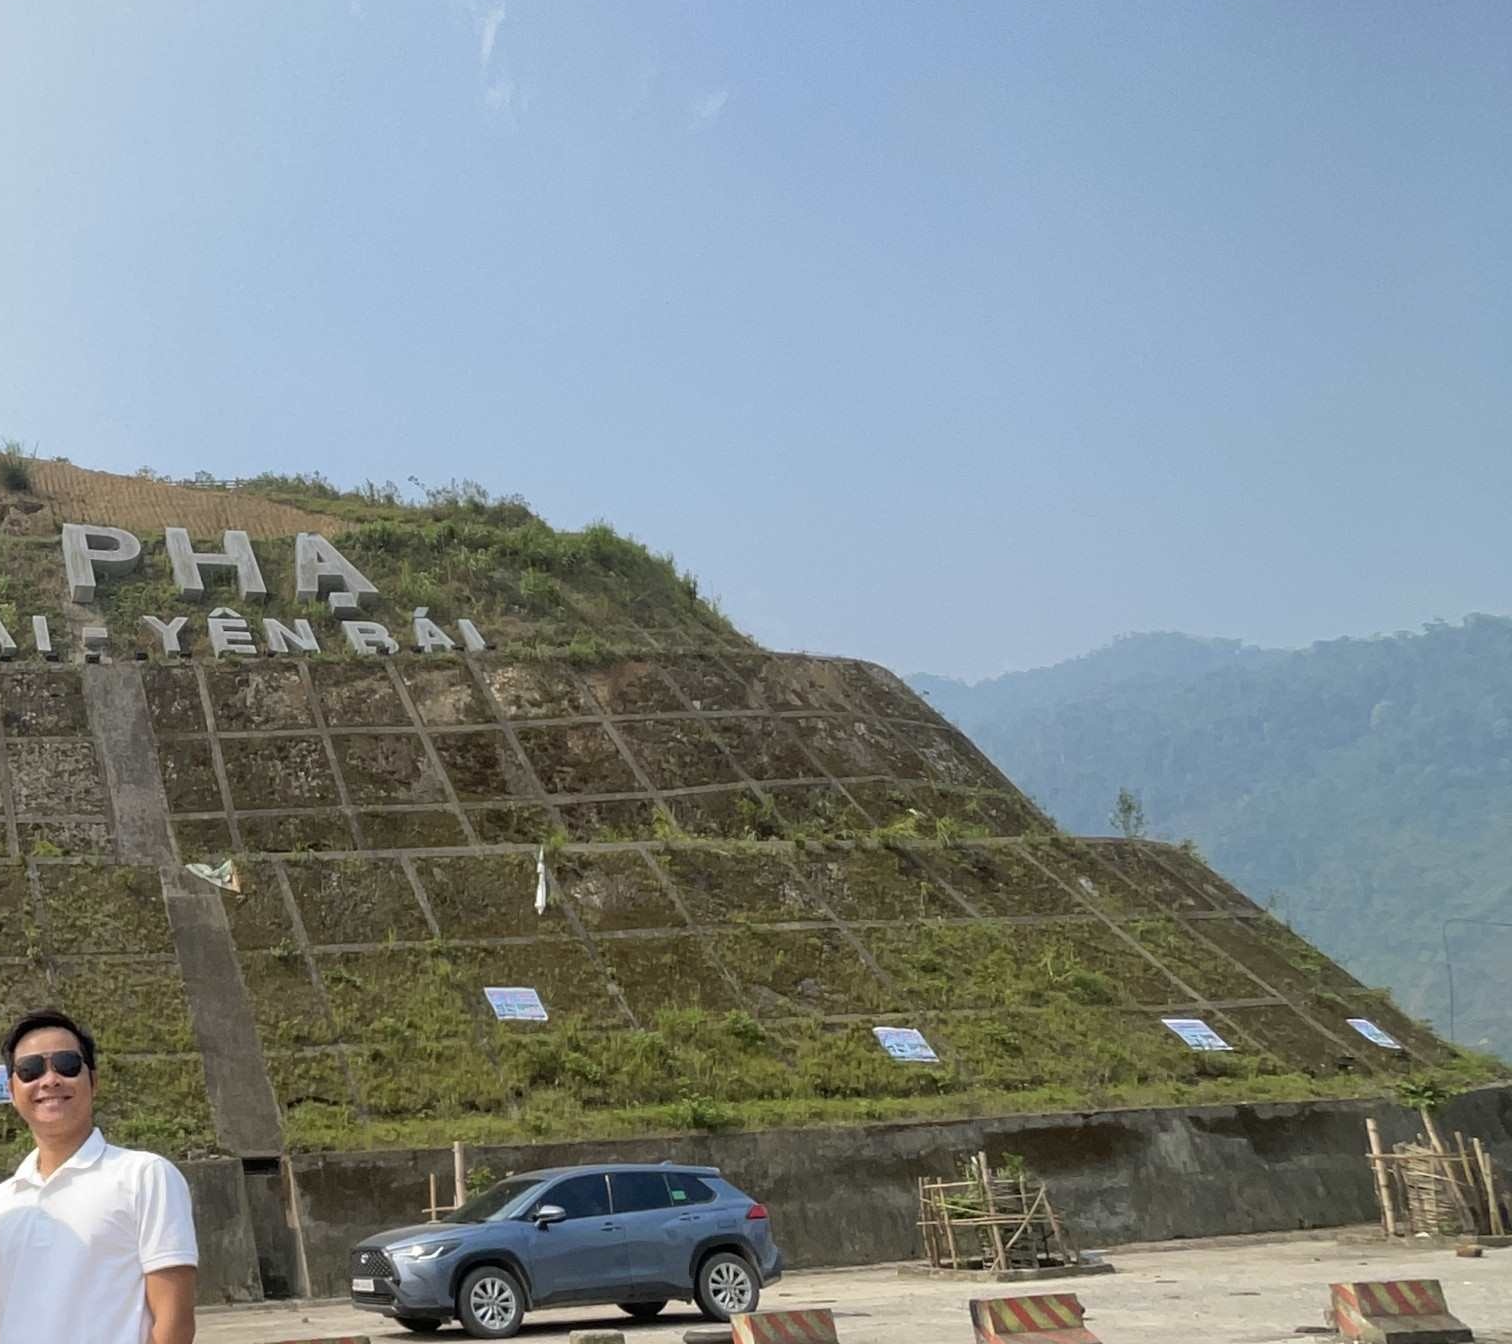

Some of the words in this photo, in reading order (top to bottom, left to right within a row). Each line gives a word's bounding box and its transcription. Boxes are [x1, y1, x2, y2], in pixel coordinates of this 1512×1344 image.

[62, 523, 380, 611] PHẠ
[143, 607, 321, 655] YÊN
[340, 606, 487, 654] BÁI
